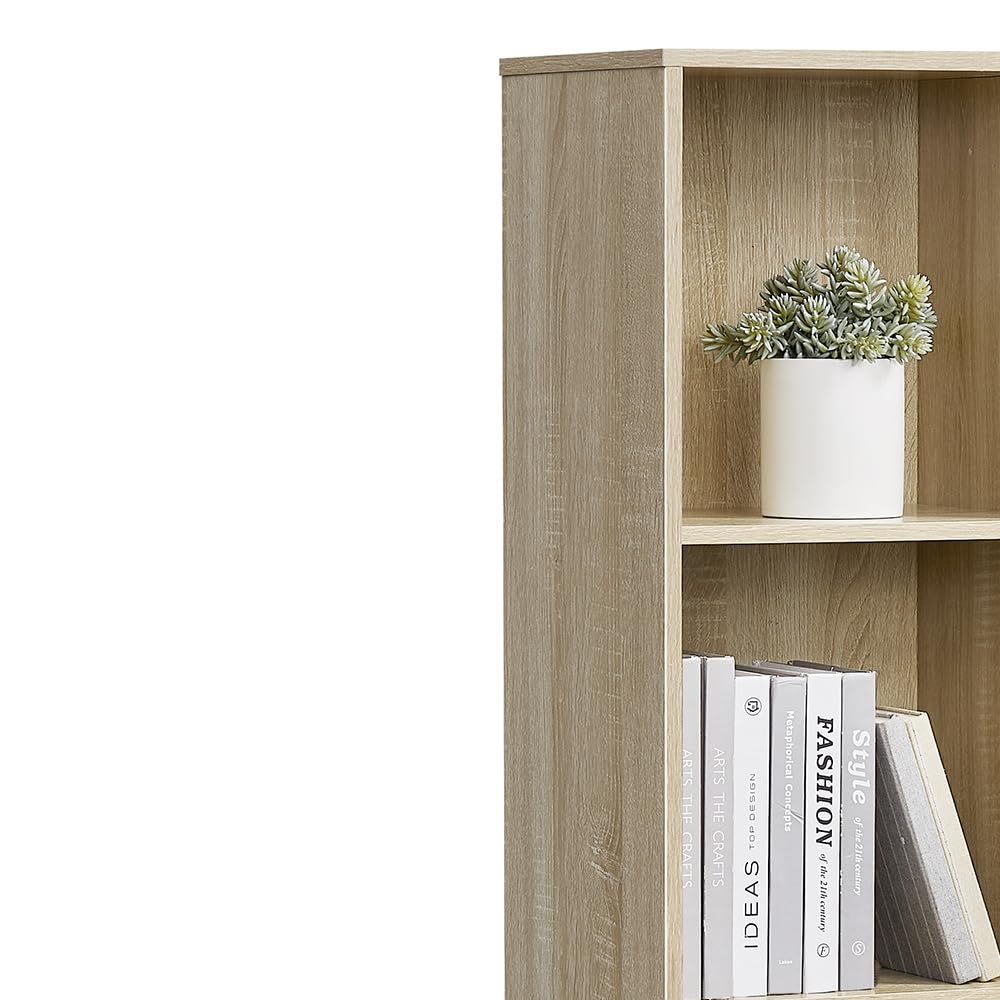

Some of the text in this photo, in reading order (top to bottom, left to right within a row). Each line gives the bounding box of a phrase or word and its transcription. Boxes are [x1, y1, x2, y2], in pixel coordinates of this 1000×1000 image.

[784, 711, 794, 832] Metaphorical Concepts
[815, 716, 834, 848] FASHION
[847, 729, 871, 805] Style
[712, 747, 725, 888] ARTS THE CRAFTS
[853, 817, 864, 828] of
[855, 829, 863, 843] the
[819, 853, 828, 864] of
[820, 865, 828, 879] the
[744, 860, 760, 948] IDEAS
[818, 900, 826, 932] century
